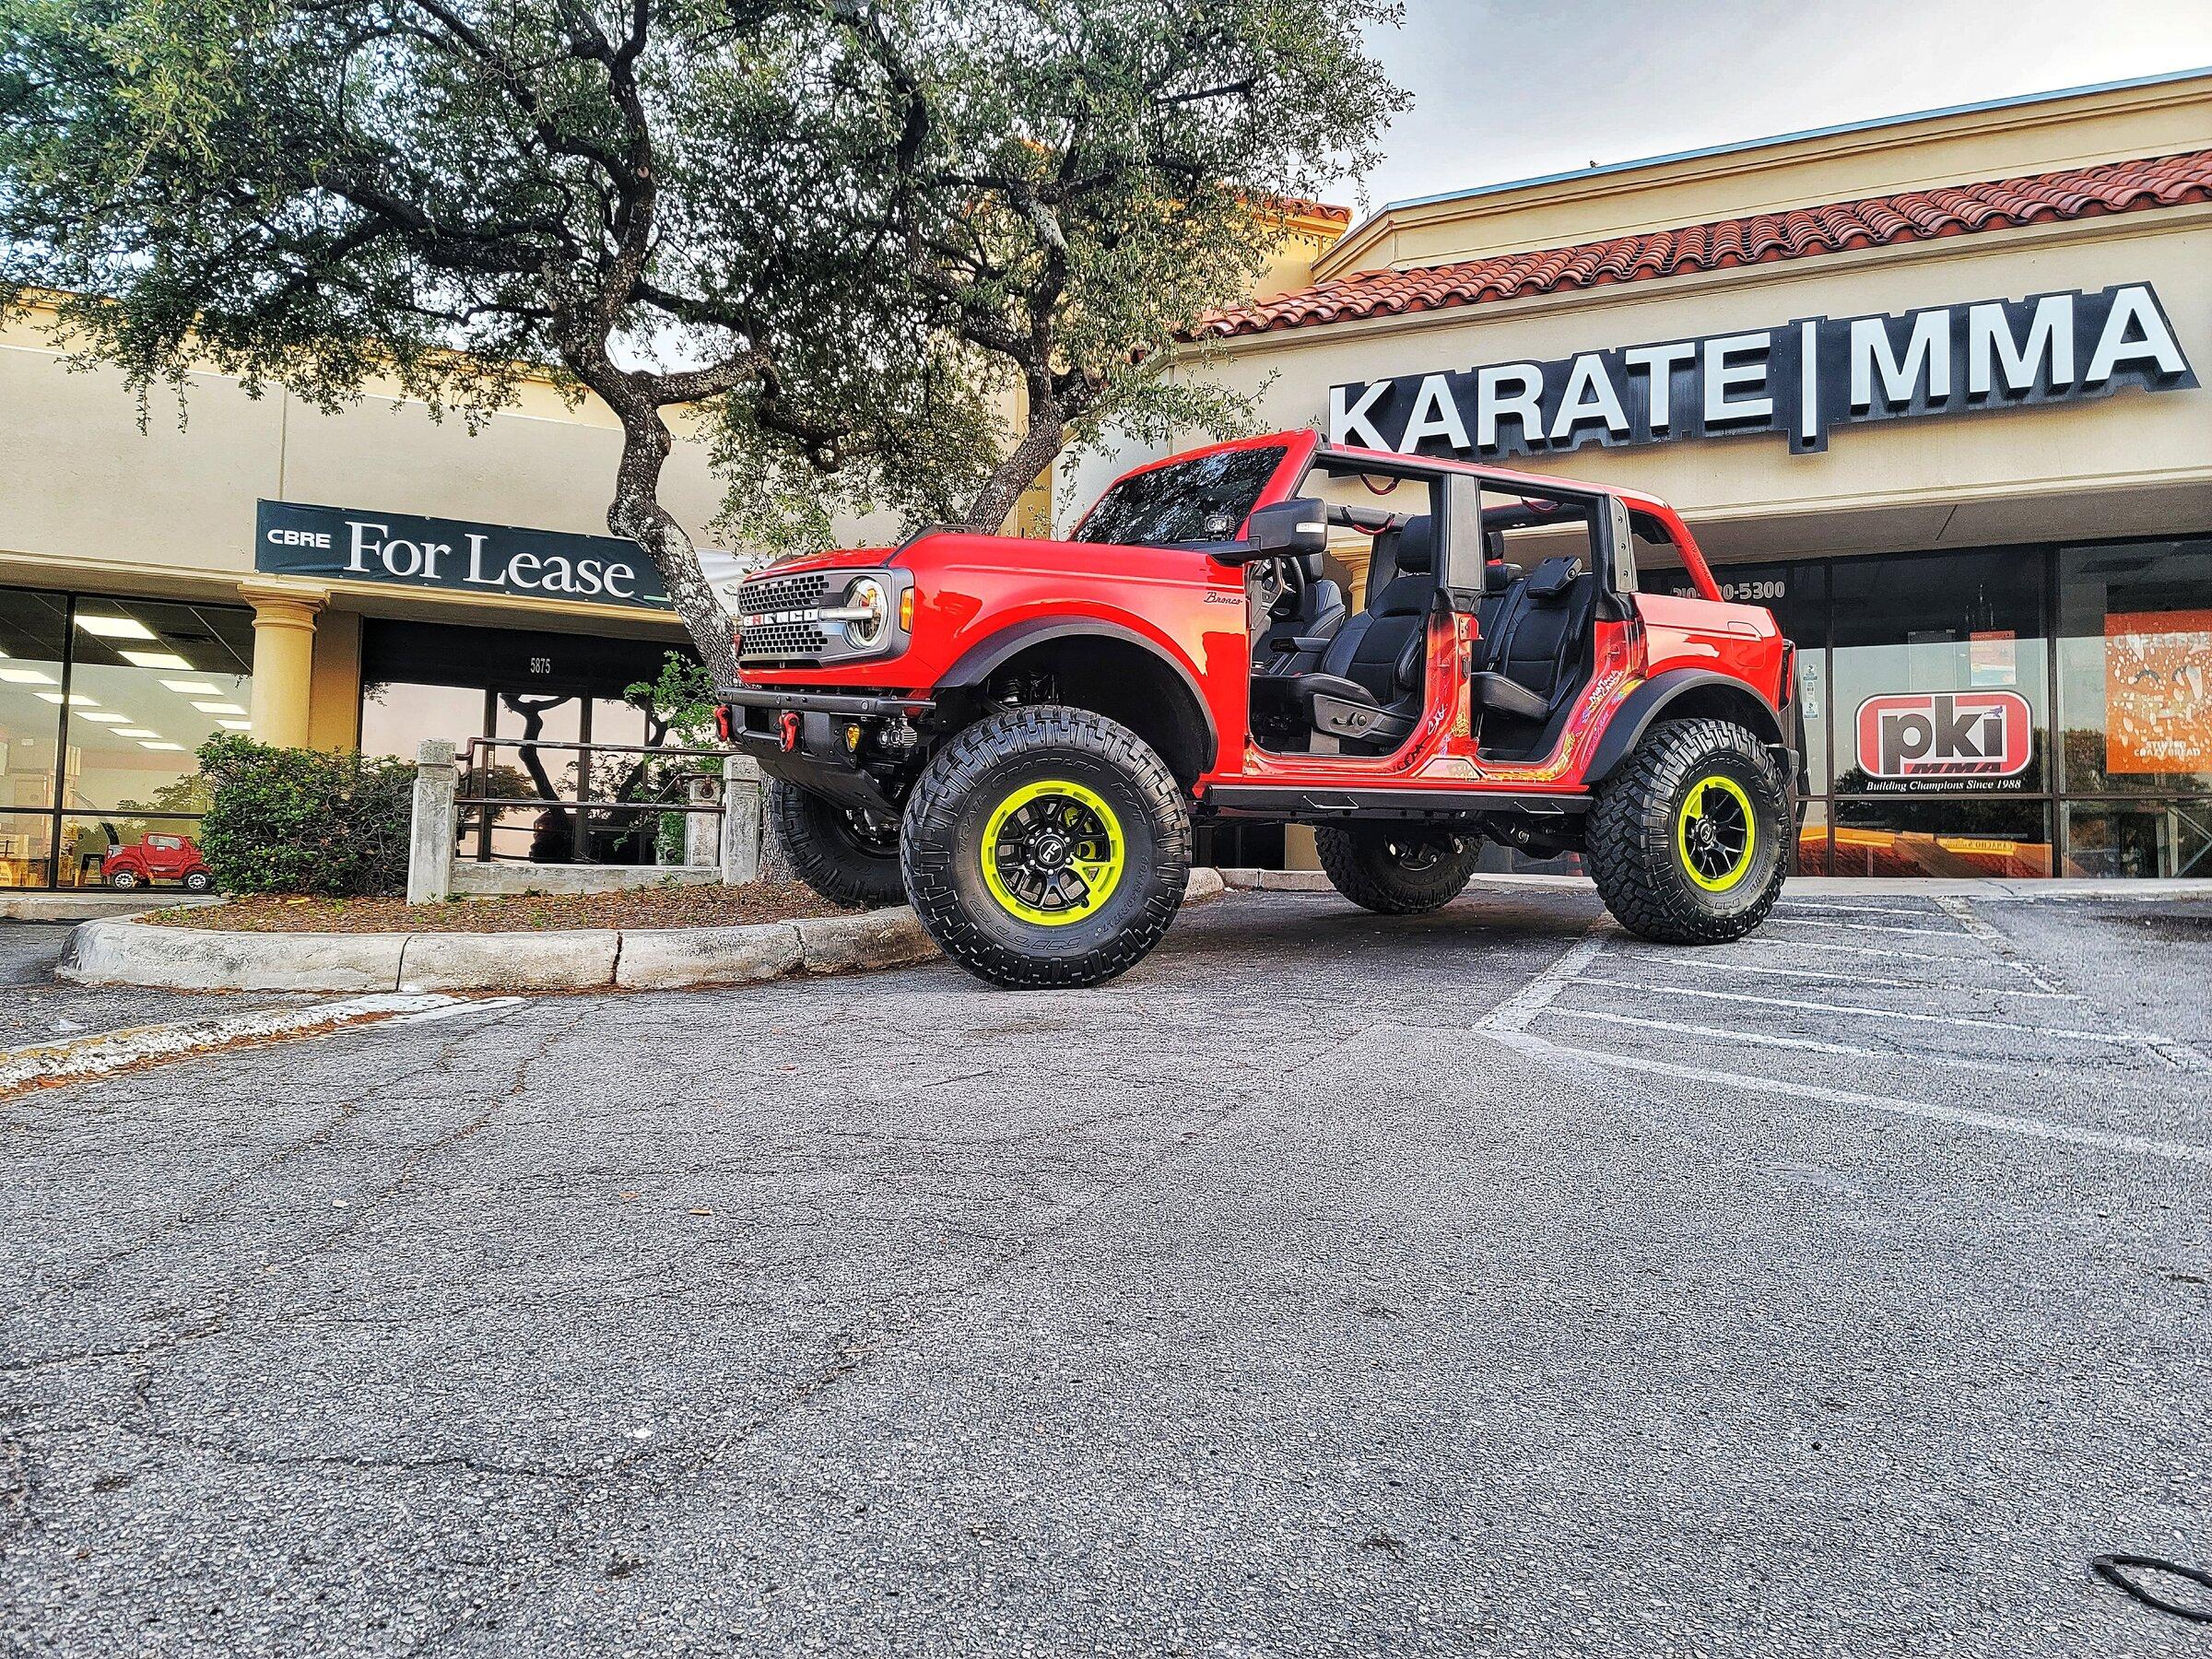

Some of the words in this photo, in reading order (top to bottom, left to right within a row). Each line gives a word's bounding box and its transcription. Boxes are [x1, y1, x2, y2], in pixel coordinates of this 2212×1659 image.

[1330, 331, 1773, 453] KARATE
[1849, 285, 2187, 406] MMA
[267, 528, 331, 549] CBRE
[343, 521, 452, 580] For
[463, 533, 636, 599] Lease
[1204, 591, 1243, 606] Bronco
[530, 657, 551, 674] 5875
[1882, 695, 2003, 775] pki
[1910, 762, 2001, 774] MMA
[1866, 781, 1907, 793] Building
[1909, 780, 1964, 792] Champions
[1966, 780, 1994, 790] Since
[1996, 779, 2021, 789] 1988
[968, 900, 1082, 951] NITTO
